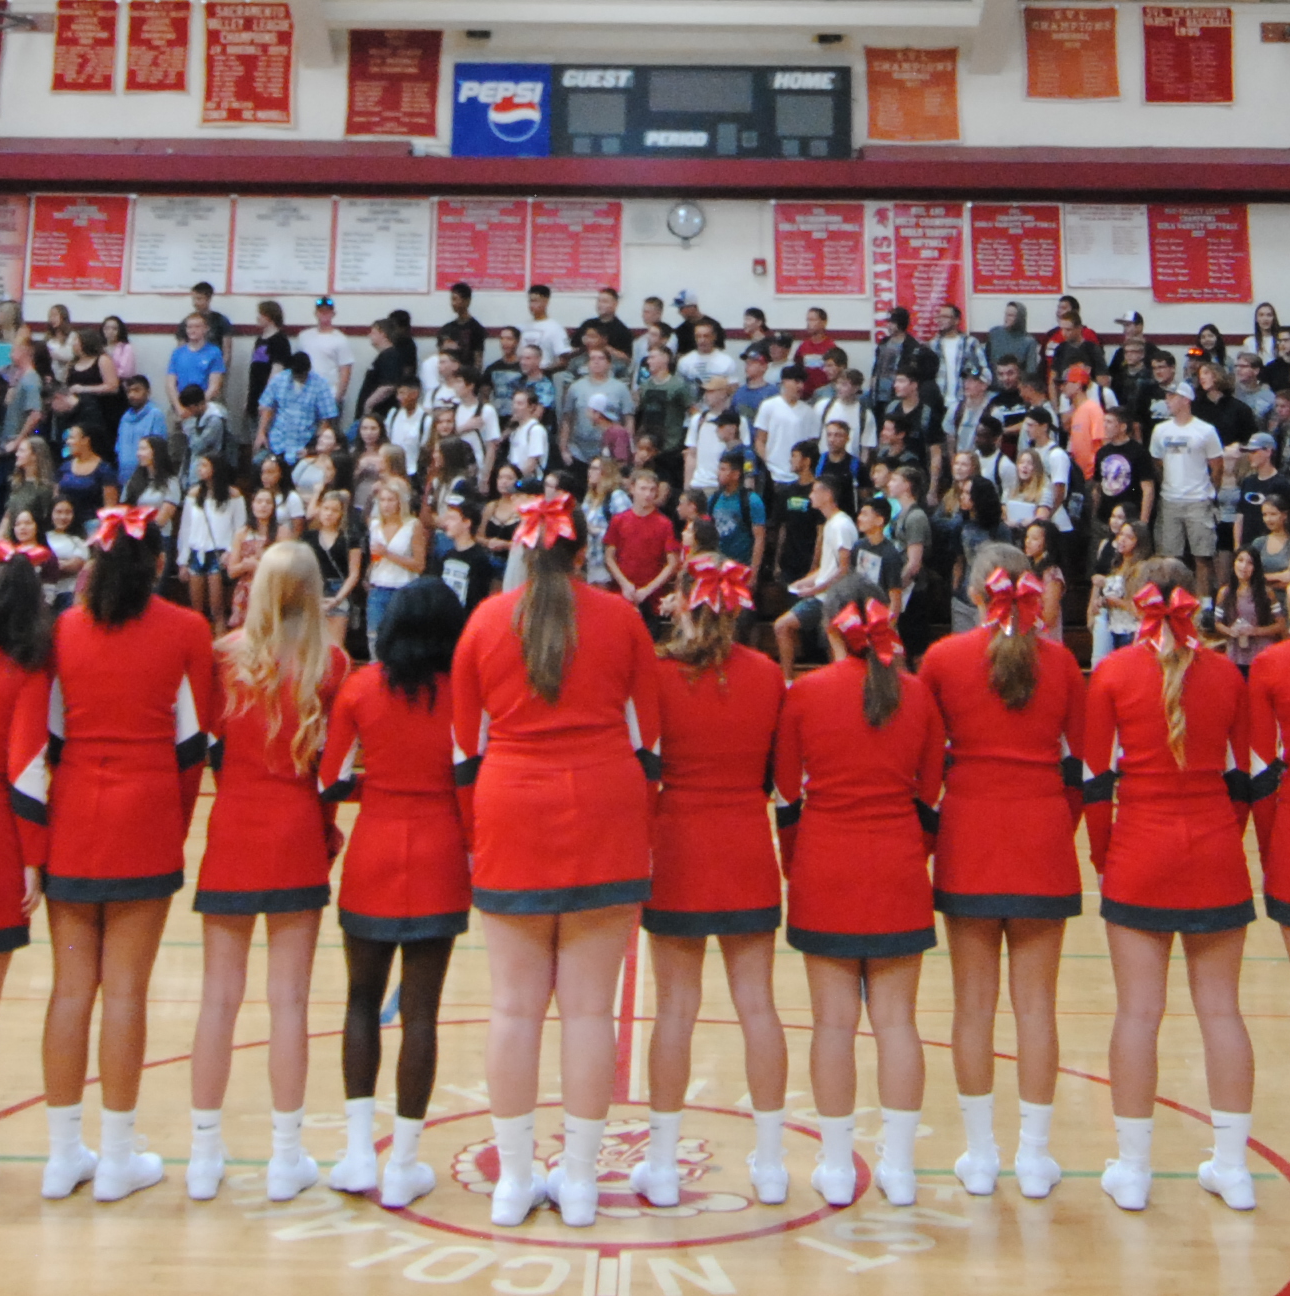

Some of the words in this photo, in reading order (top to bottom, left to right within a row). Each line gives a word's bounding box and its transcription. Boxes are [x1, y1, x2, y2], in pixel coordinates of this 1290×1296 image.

[1031, 21, 1112, 32] CHAMPIONS
[873, 62, 954, 72] CHAMPIONS
[561, 69, 634, 88] GUEST
[773, 72, 837, 89] HOME
[458, 81, 544, 104] PEPSI
[644, 130, 708, 147] PERIOD
[872, 235, 894, 345] PARTANS
